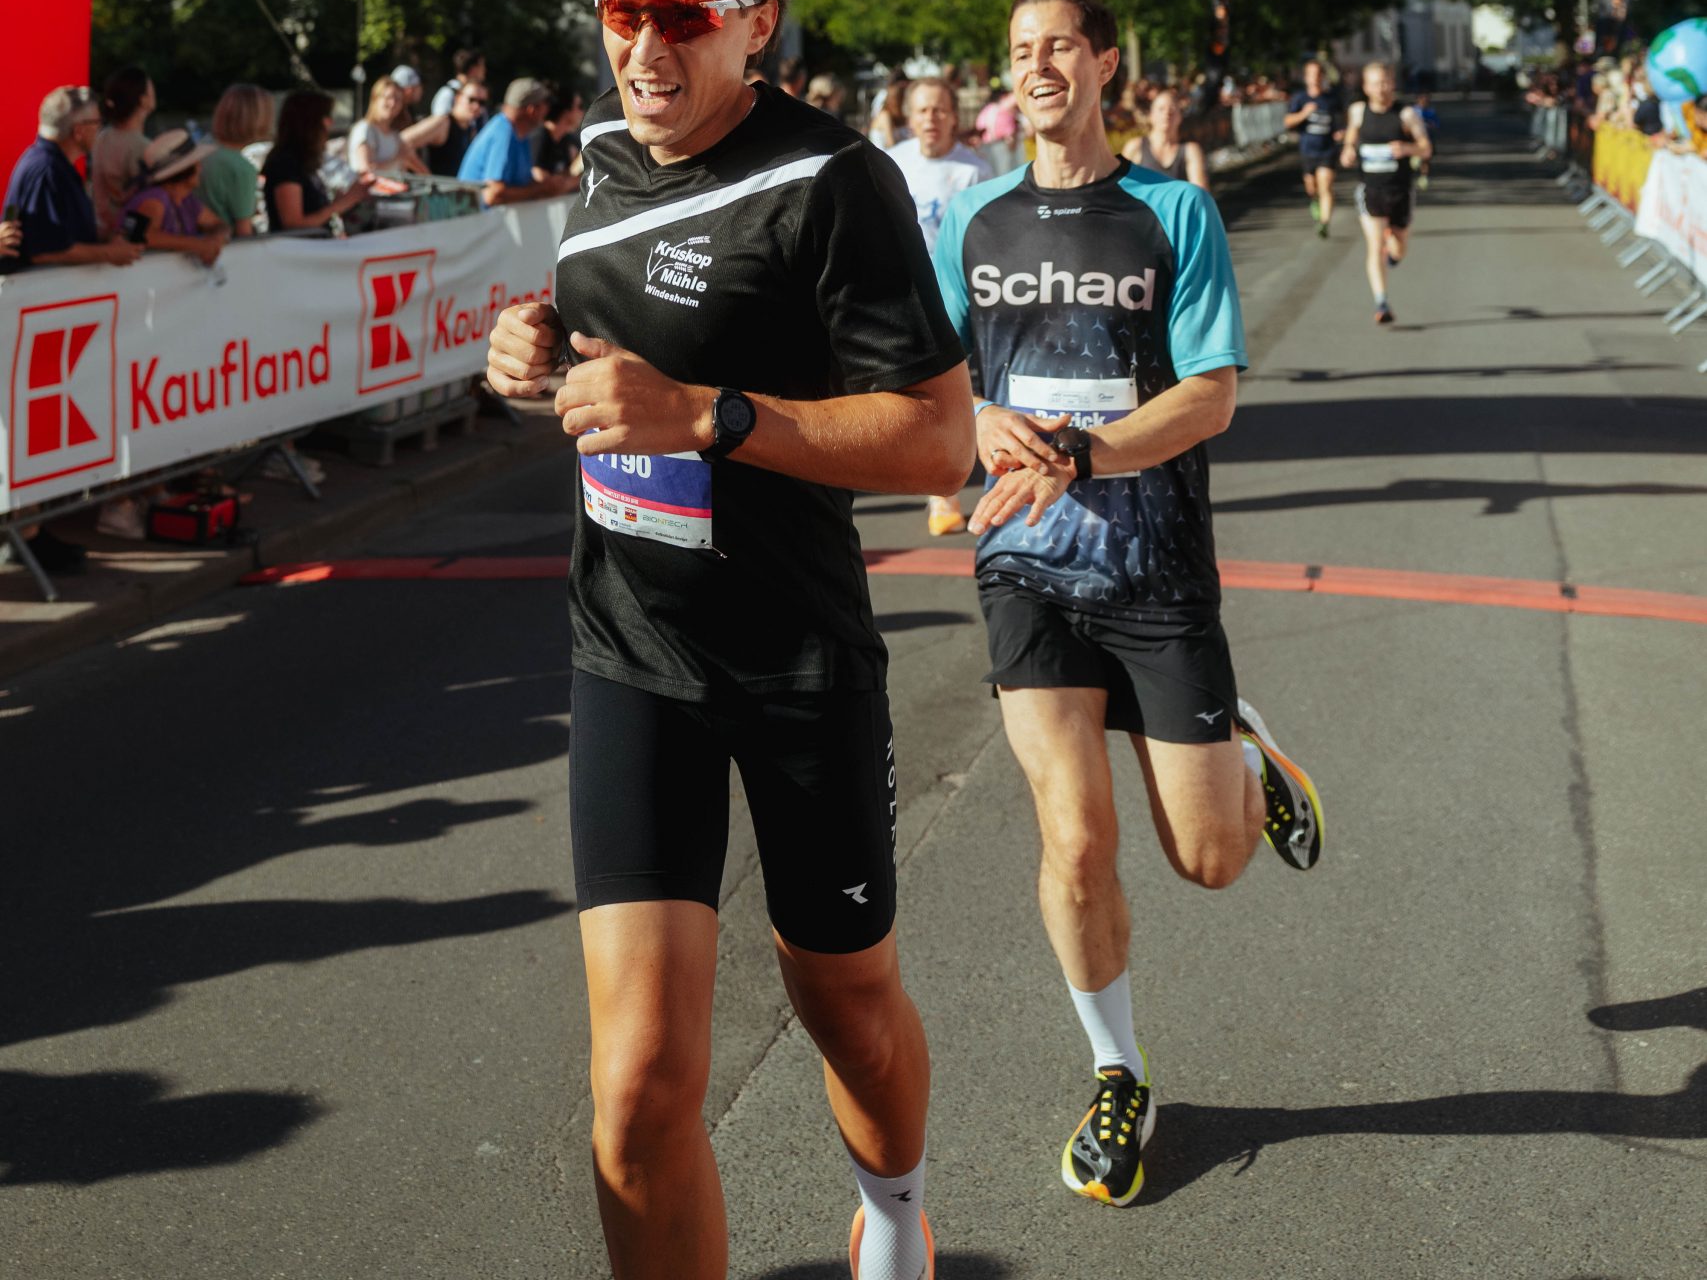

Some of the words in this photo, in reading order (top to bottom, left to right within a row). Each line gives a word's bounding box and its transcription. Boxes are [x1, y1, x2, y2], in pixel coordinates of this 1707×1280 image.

[654, 240, 713, 270] Kruskop
[644, 283, 699, 308] Windesheim
[660, 268, 708, 293] Mühle
[971, 261, 1156, 311] Schad
[432, 270, 554, 354] Kaufld
[130, 322, 330, 431] Kaufland
[1035, 409, 1107, 431] Prick
